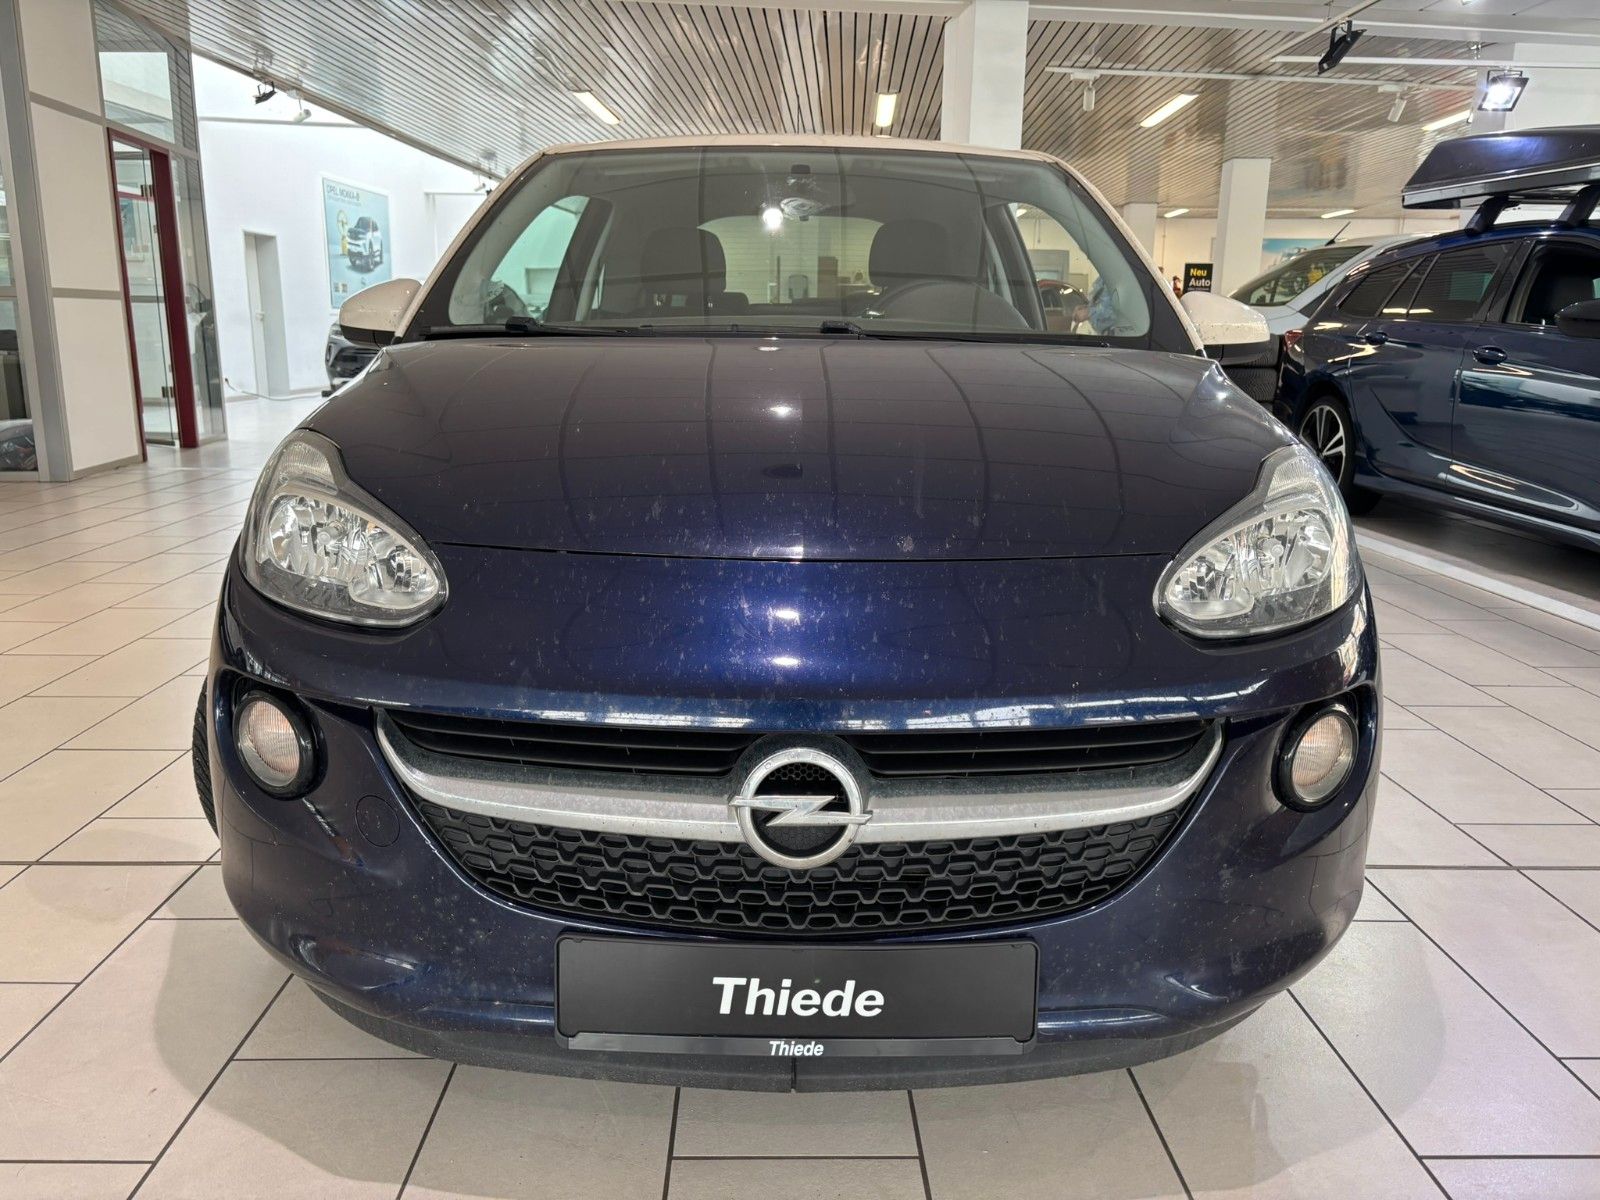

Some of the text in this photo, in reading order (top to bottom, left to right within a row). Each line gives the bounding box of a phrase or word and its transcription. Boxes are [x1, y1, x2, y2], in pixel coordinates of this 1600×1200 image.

[1190, 268, 1207, 276] Neu
[1189, 277, 1211, 286] Auto
[712, 976, 885, 1017] Thiede
[769, 1040, 824, 1057] Thiede
